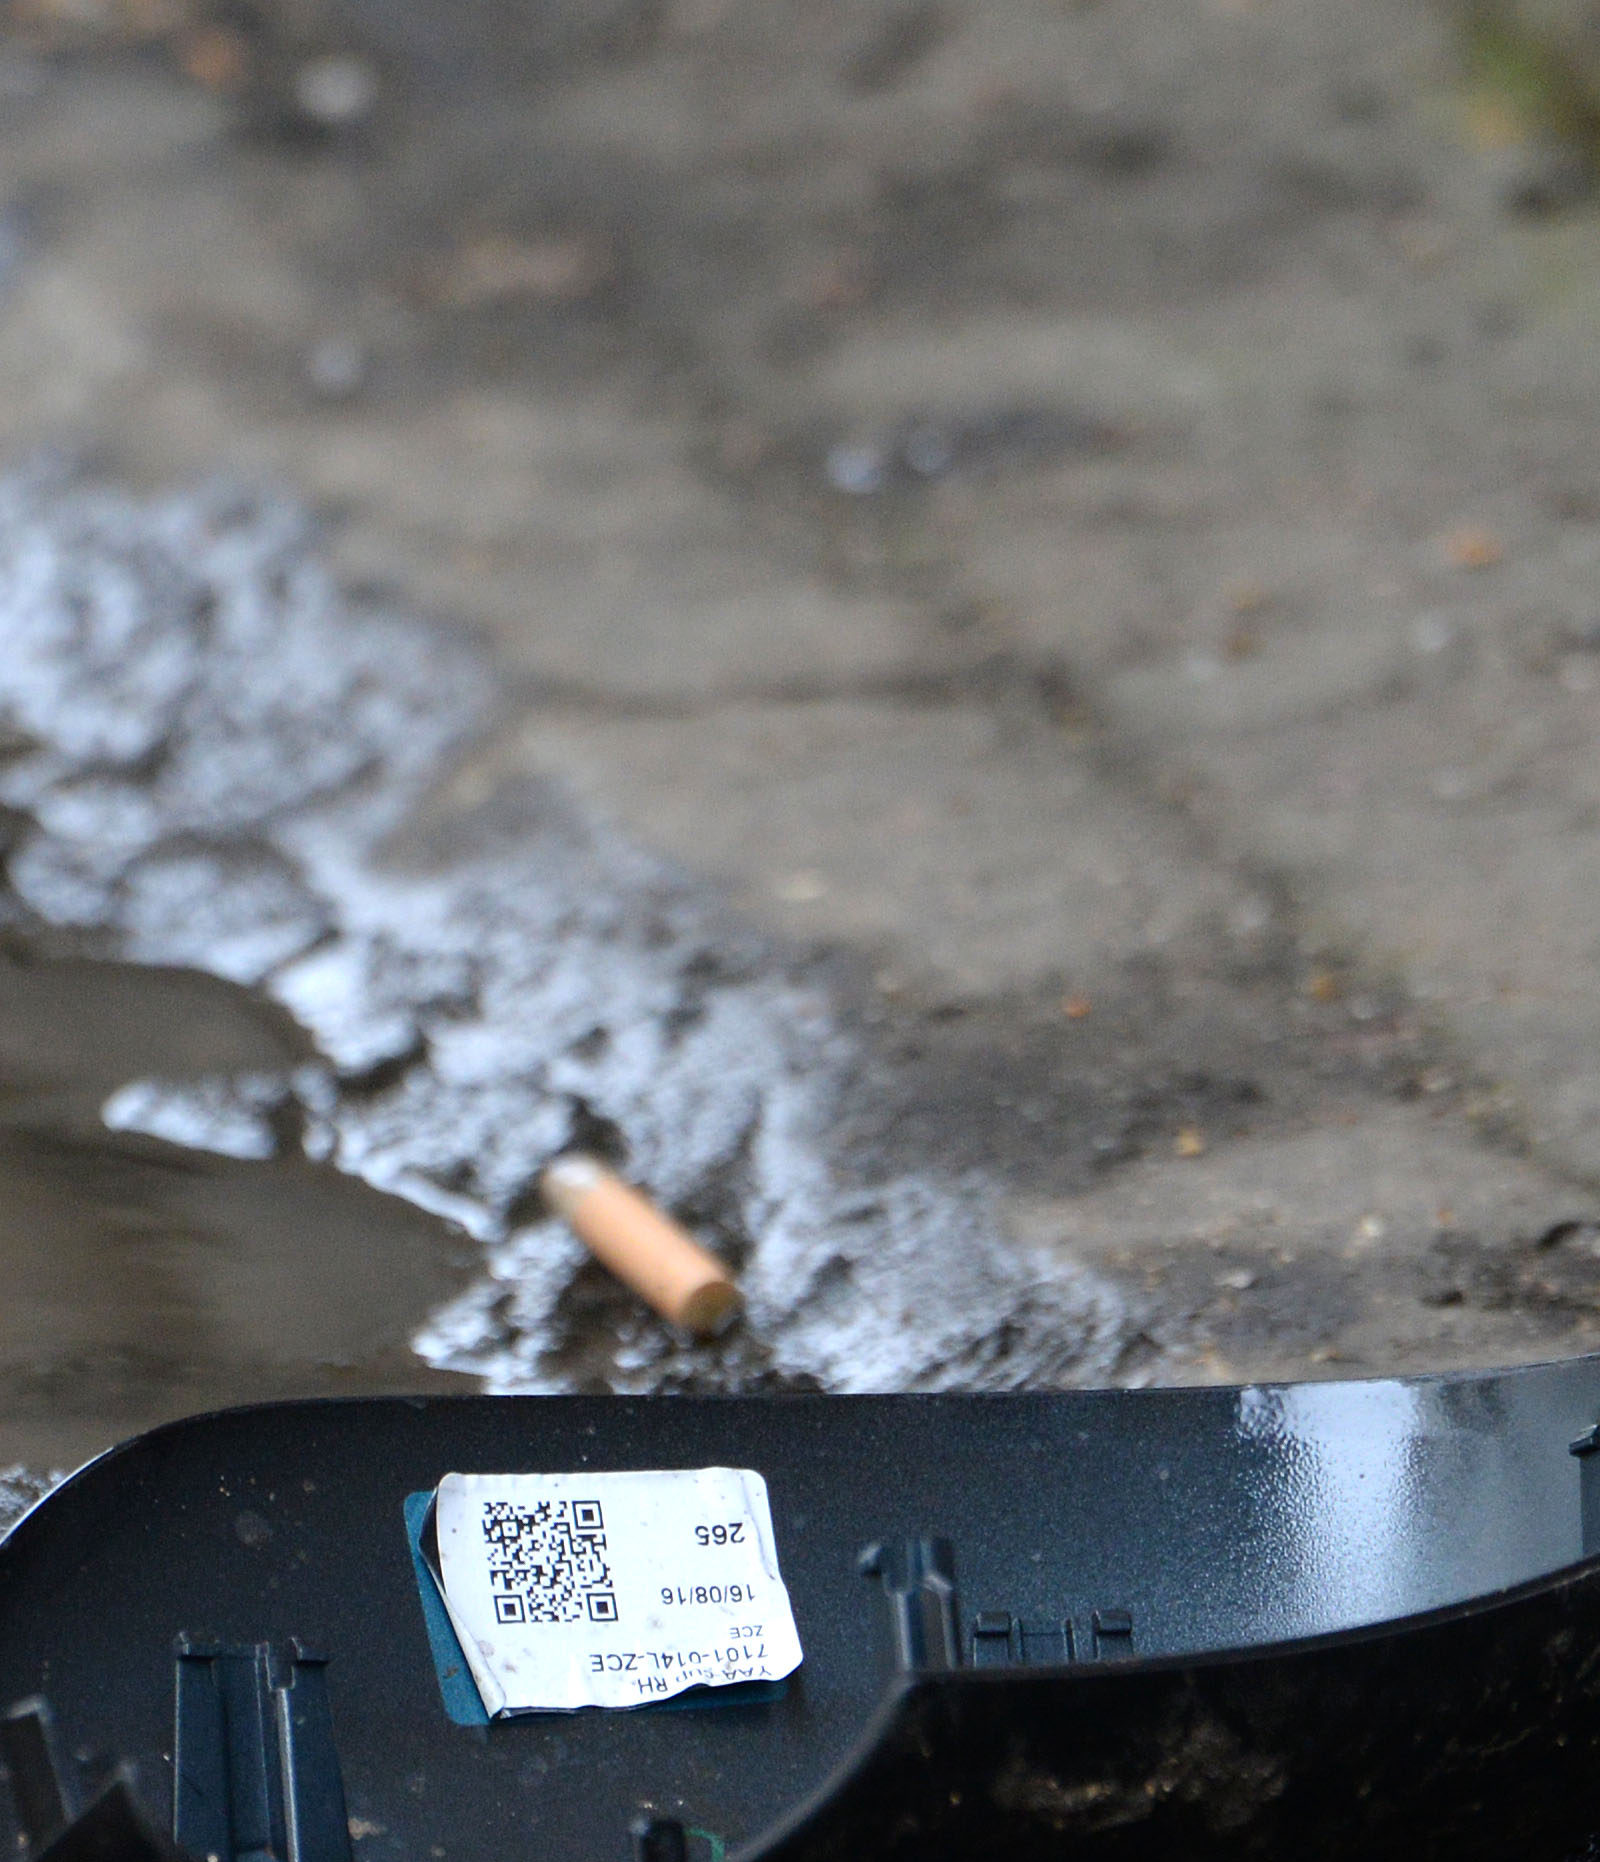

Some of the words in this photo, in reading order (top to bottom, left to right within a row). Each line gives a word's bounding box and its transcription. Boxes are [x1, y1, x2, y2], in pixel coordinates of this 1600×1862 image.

[695, 1522, 745, 1546] 265
[661, 1584, 756, 1605] 16/08/16
[729, 1625, 763, 1639] ZCE
[589, 1644, 769, 1672] 7101-014L-ZCE
